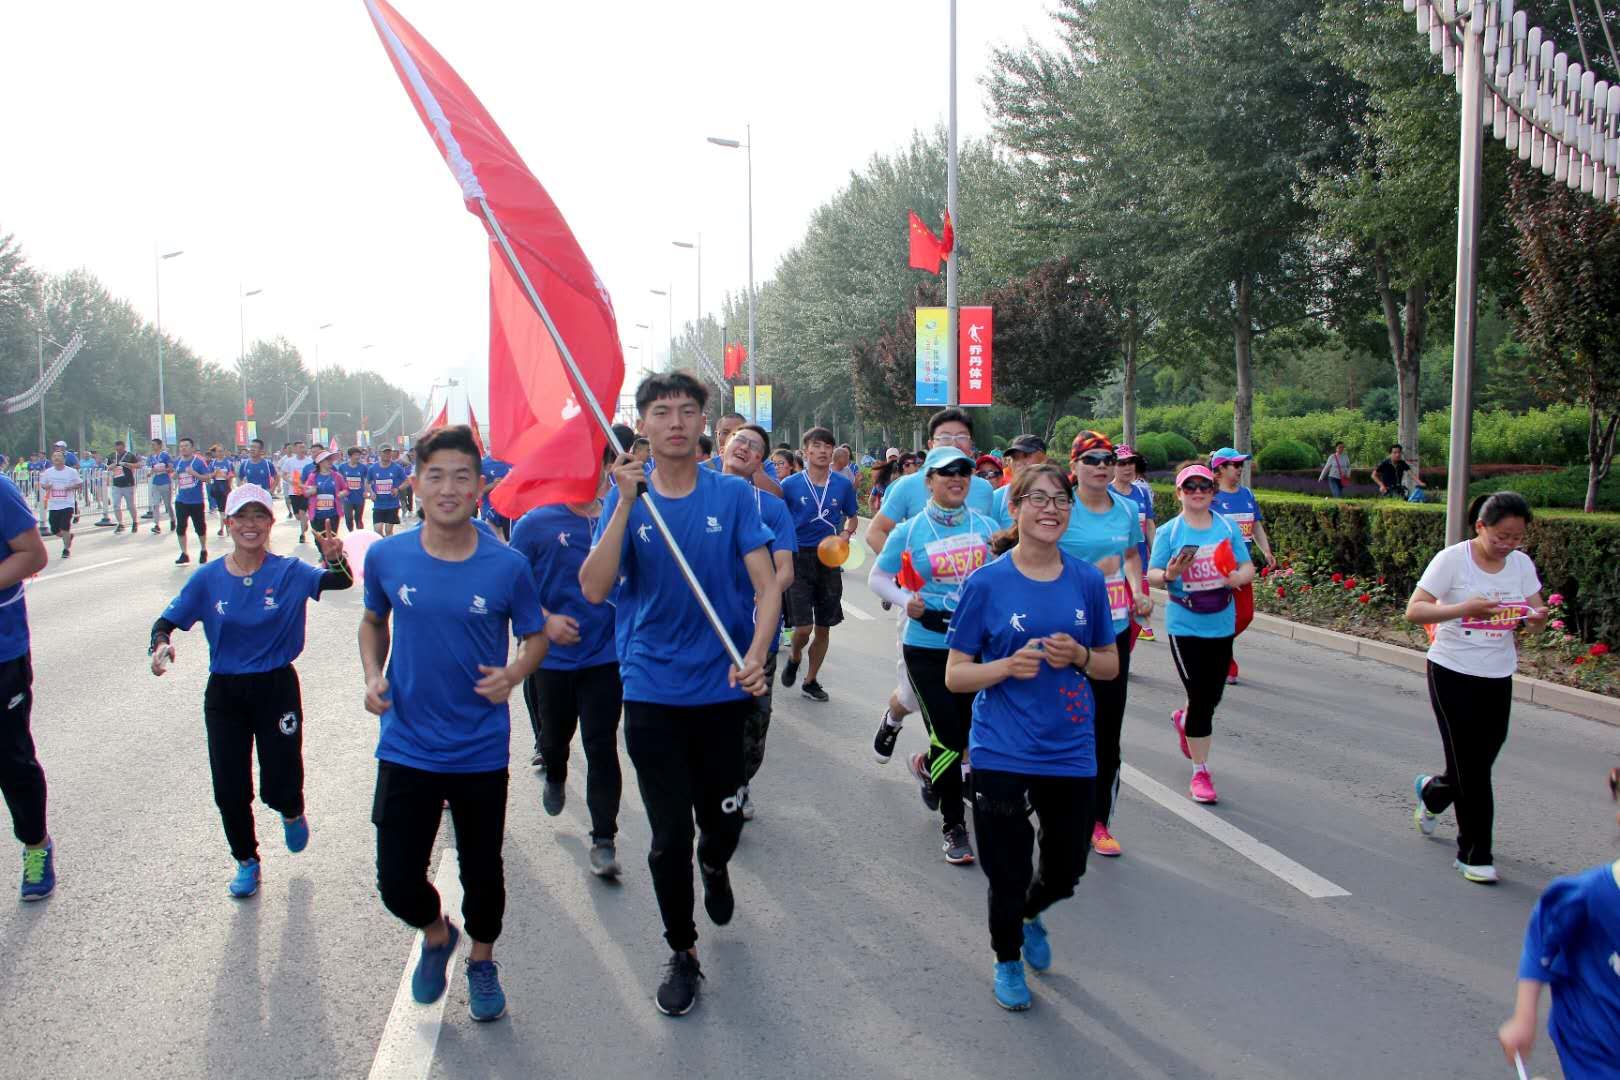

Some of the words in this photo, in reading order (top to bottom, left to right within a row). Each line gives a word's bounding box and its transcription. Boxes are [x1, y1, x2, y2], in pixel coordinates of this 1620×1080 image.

[968, 344, 983, 390] 乔丹体育
[936, 549, 984, 575] 22578
